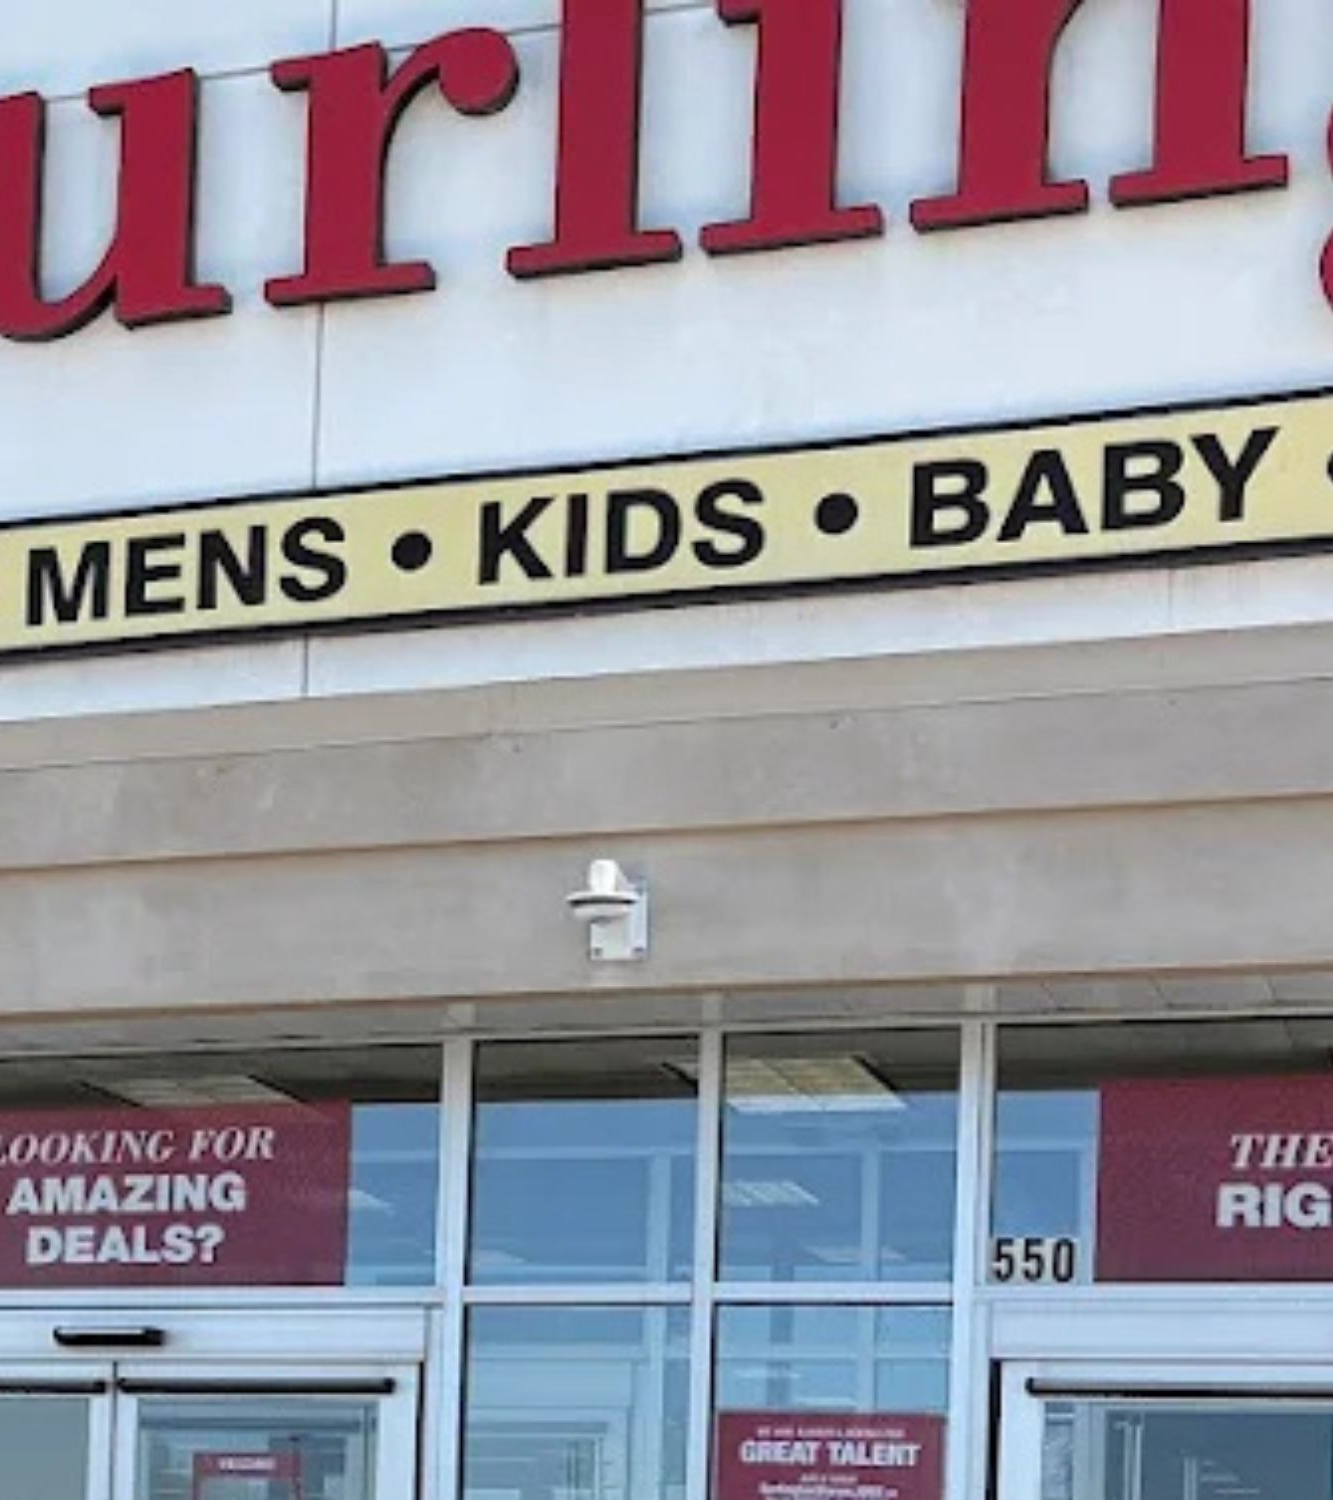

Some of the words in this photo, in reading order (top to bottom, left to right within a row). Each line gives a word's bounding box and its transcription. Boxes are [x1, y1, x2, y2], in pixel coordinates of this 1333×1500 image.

[25, 516, 347, 626] MENS
[477, 479, 765, 585] KIDS
[909, 427, 1279, 548] BABY
[188, 1126, 276, 1161] FOR
[1230, 1133, 1333, 1170] THE
[5, 1171, 247, 1216] AMAZING
[26, 1224, 226, 1264] DEALS?
[992, 1237, 1076, 1284] 550
[740, 1438, 820, 1466] GREAT
[826, 1441, 921, 1467] TALENT
